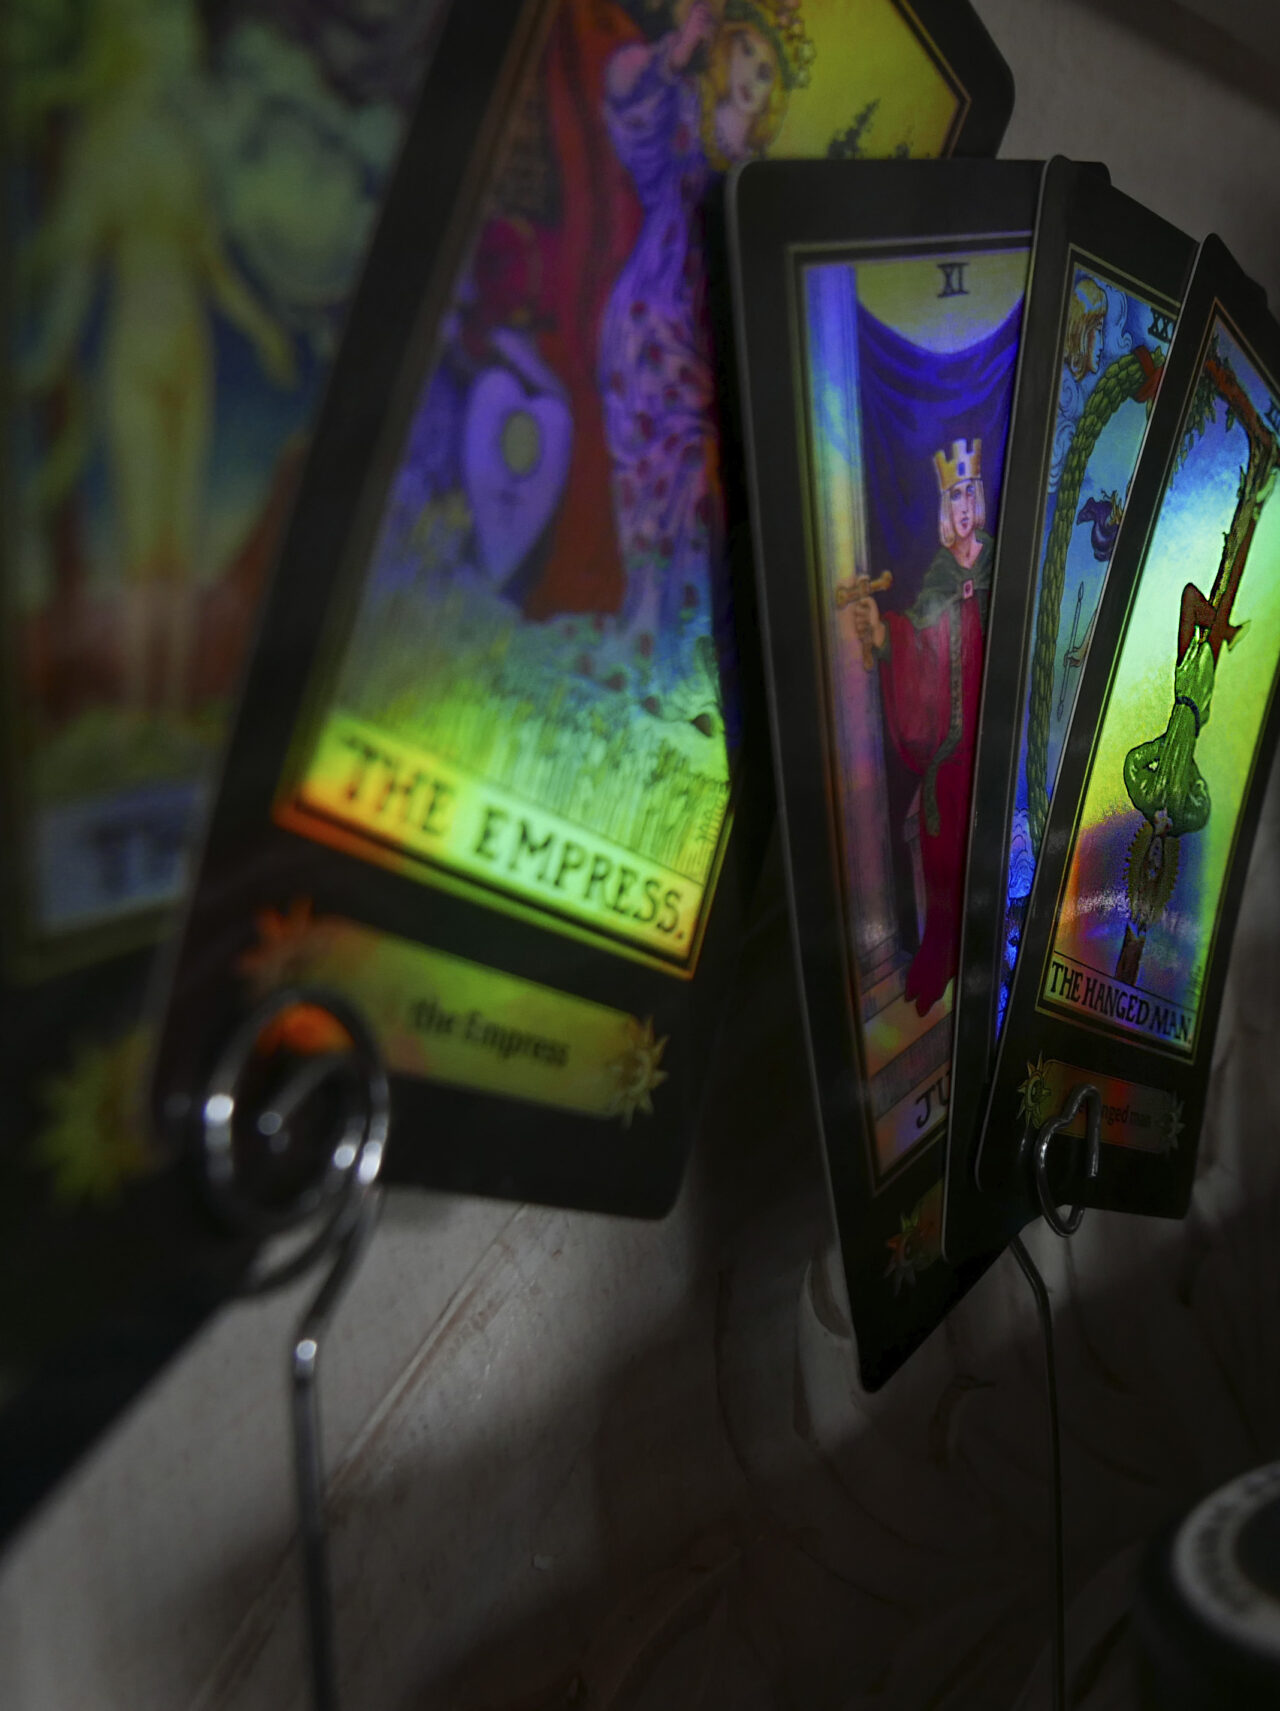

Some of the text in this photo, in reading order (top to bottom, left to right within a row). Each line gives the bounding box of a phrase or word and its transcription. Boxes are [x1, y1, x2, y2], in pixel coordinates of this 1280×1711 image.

[937, 262, 970, 298] XI
[343, 735, 455, 838] THE
[471, 803, 685, 940] EMPRESS.
[1050, 961, 1084, 1003] THE
[1081, 976, 1150, 1025] HANGED
[411, 998, 571, 1068] the Empress
[1101, 1104, 1130, 1126] nged
